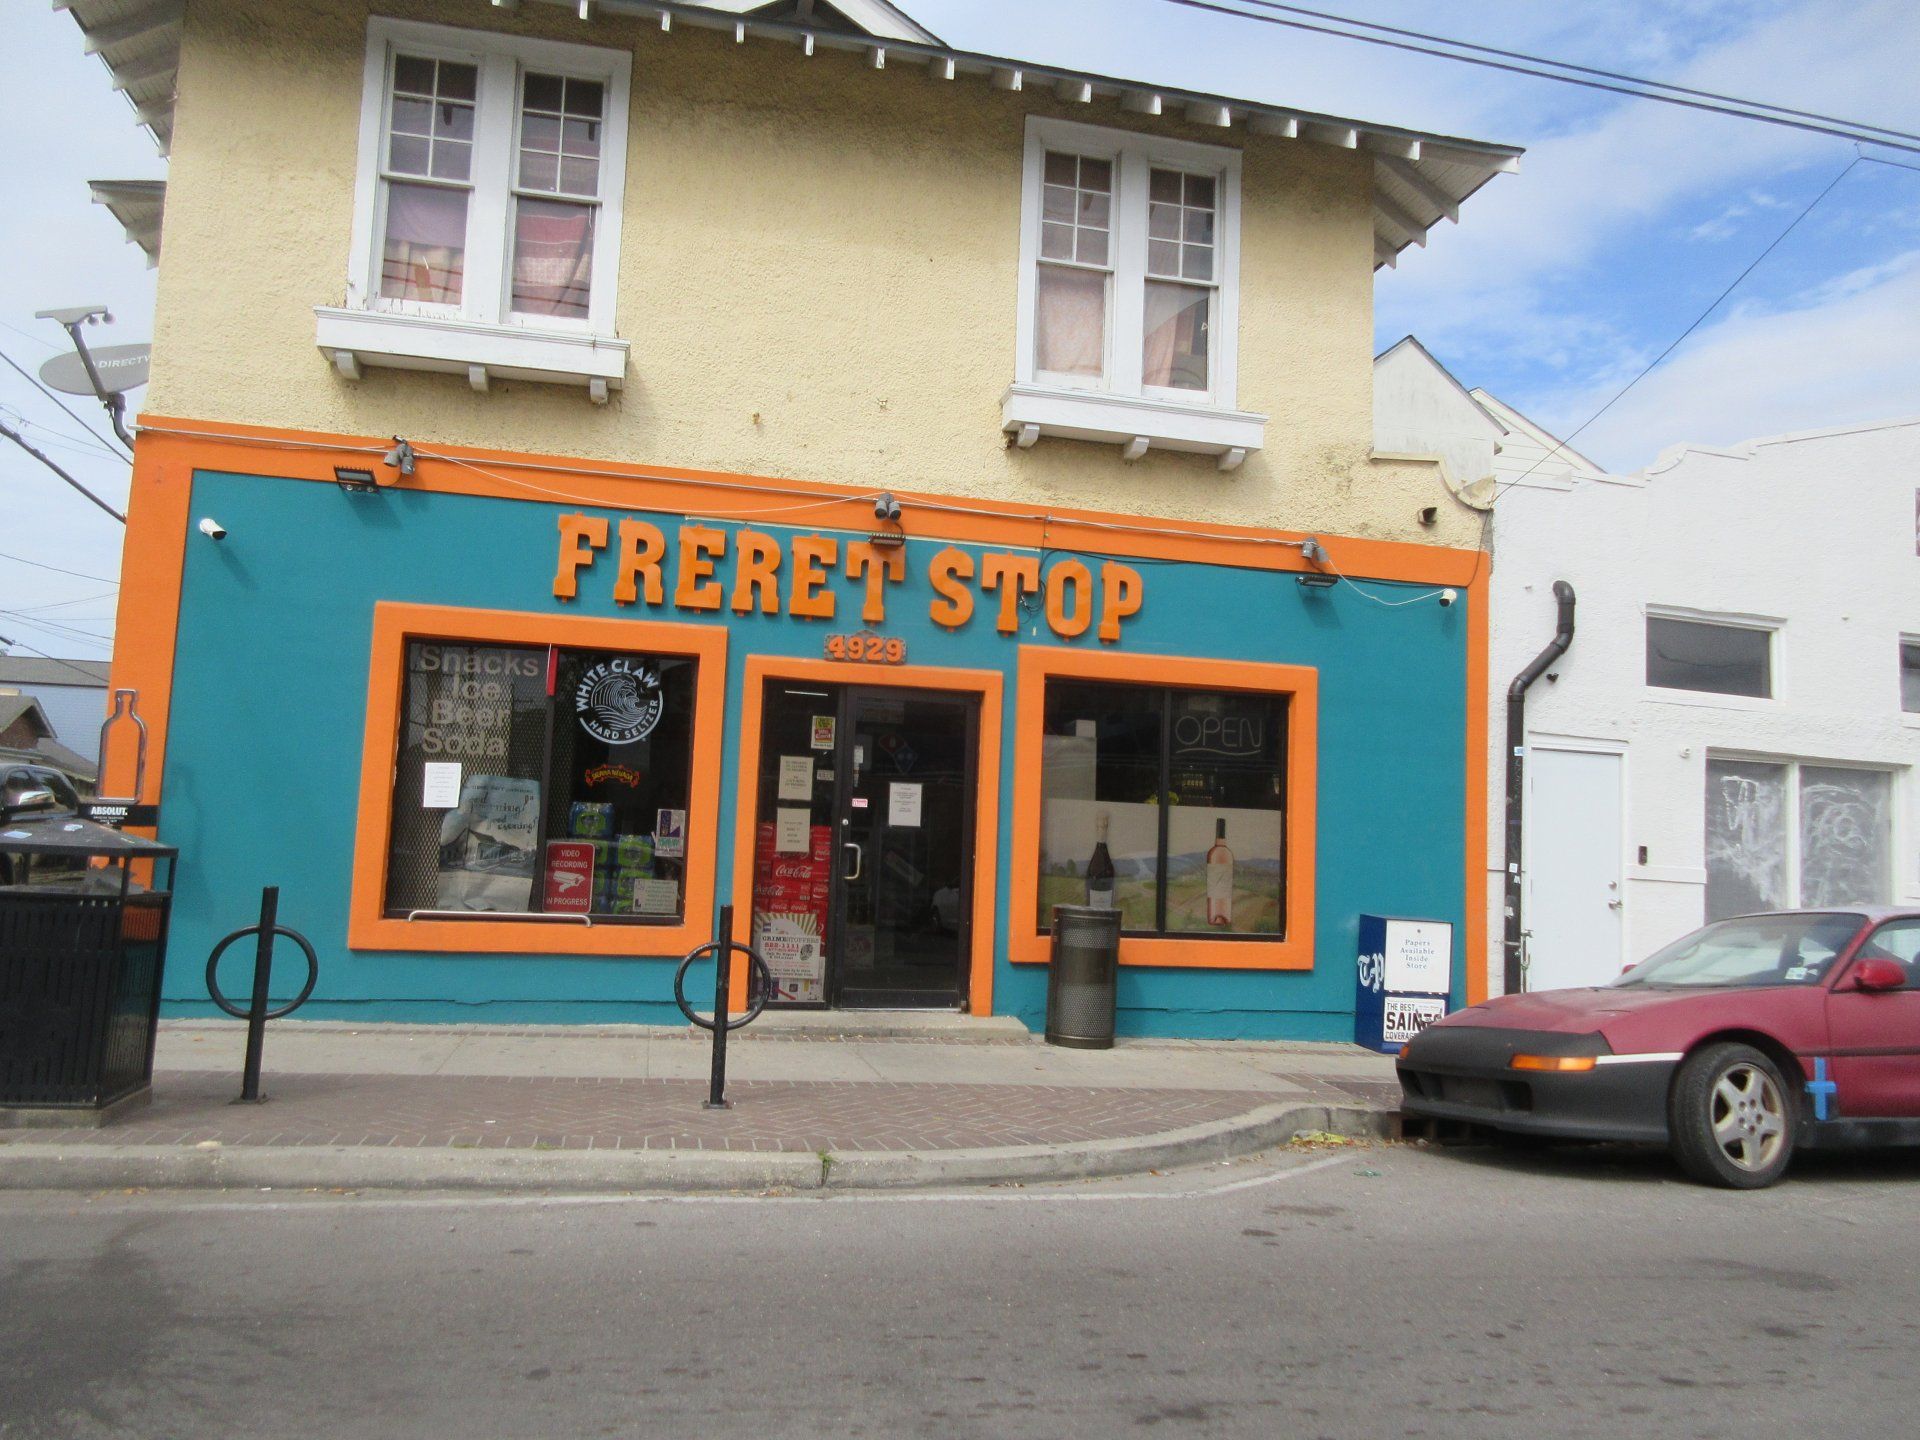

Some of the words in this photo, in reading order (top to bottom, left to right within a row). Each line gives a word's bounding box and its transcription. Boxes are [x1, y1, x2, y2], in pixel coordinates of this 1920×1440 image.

[552, 512, 906, 622] FRERET
[928, 546, 1143, 641] STOP
[421, 646, 539, 677] Snacks
[828, 636, 904, 662] 4929
[452, 673, 501, 702] Ice
[576, 662, 609, 713] WHITE
[611, 659, 660, 689] CLAW
[432, 700, 511, 728] Beer
[588, 720, 619, 740] HARD
[624, 699, 659, 740] SELTZER
[421, 727, 506, 756] Soda
[1175, 715, 1263, 748] OPEN
[551, 860, 588, 868] RECORDING
[560, 849, 581, 858] VIDEO
[554, 897, 588, 905] PROGRESS
[1400, 947, 1435, 955] Available
[1405, 939, 1431, 947] Papers
[1387, 1002, 1398, 1011] THE
[1400, 1003, 1415, 1011] BEST
